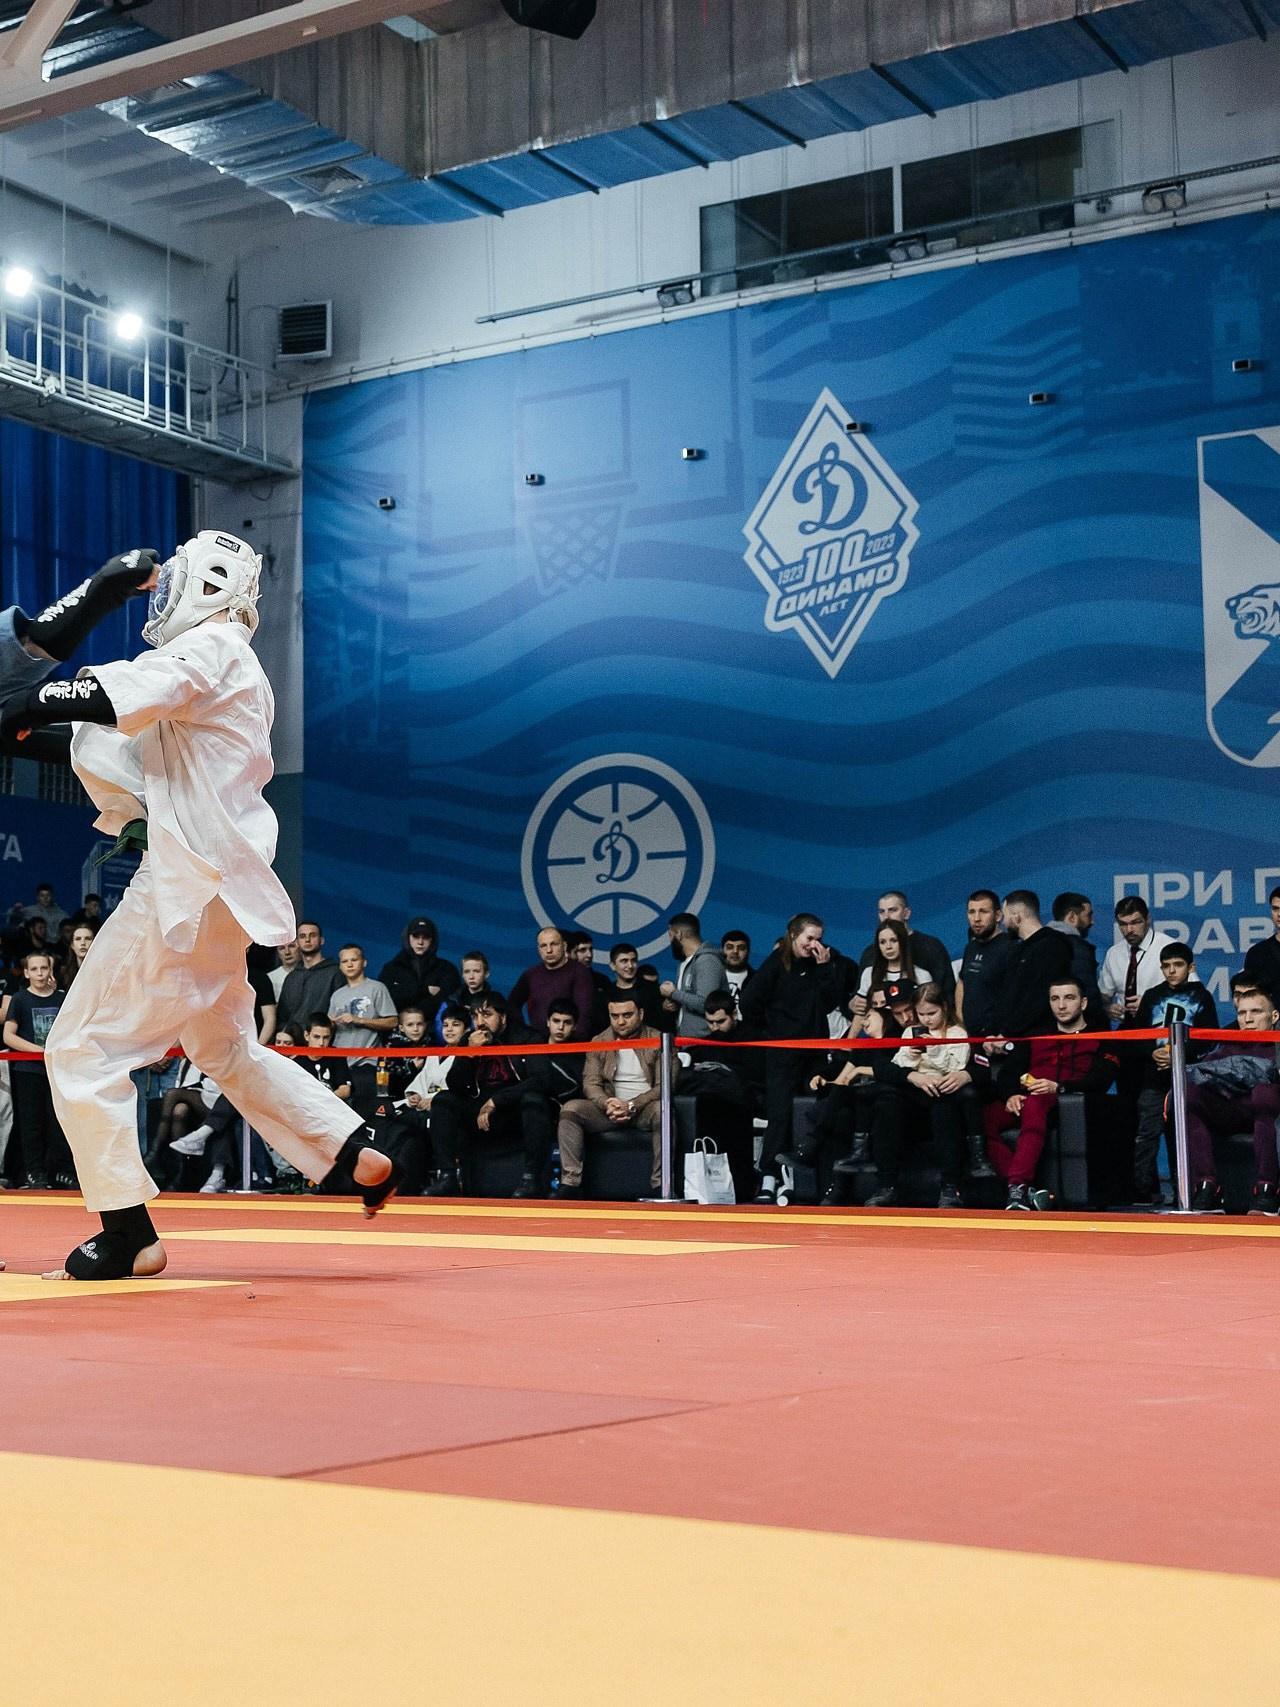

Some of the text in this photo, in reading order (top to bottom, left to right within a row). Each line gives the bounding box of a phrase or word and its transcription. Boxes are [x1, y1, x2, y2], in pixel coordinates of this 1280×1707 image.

[778, 533, 896, 592] 1923 100 2023
[777, 562, 895, 617] ДИНАМО
[819, 599, 849, 617] ЛЕТ
[1113, 867, 1280, 912] ПРИ П
[1113, 916, 1274, 955] РАВ
